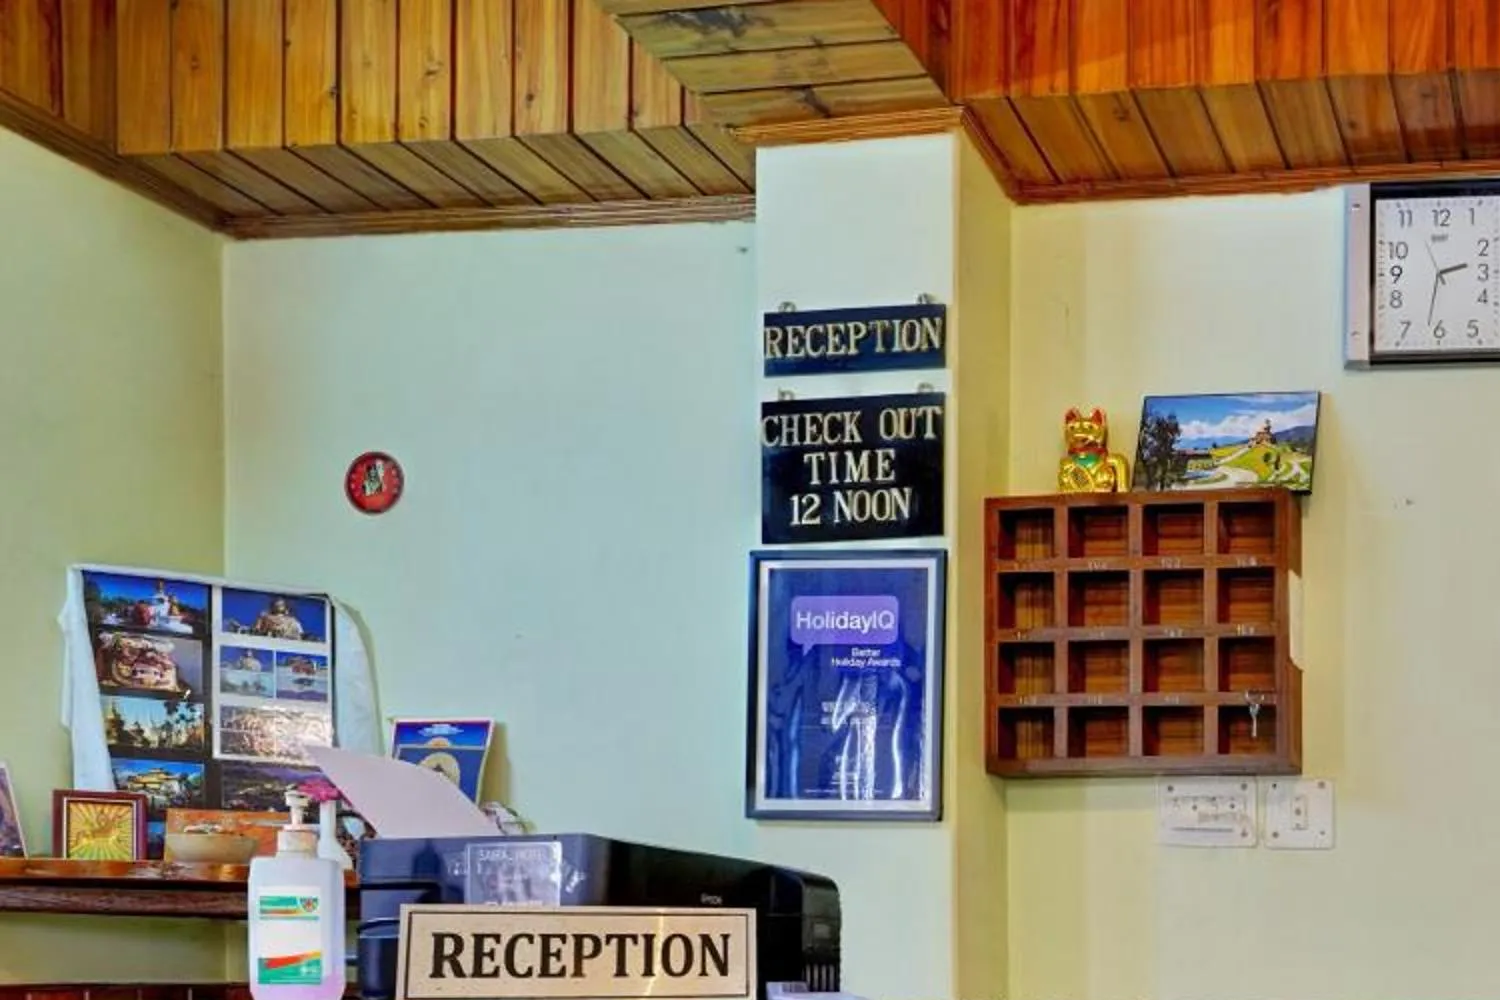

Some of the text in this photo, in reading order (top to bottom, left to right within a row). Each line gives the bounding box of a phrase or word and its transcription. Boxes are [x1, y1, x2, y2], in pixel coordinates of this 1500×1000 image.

[1398, 207, 1475, 228] 11 12 1
[1388, 241, 1409, 260] 10
[1477, 238, 1489, 257] 2
[1389, 265, 1403, 284] 9
[1477, 263, 1489, 282] 3
[1389, 290, 1403, 309] 8
[1477, 288, 1488, 304] 4
[764, 317, 943, 359] RECEPTION
[1400, 321, 1412, 339] 7
[1433, 320, 1446, 339] 6
[1466, 319, 1479, 338] 5
[762, 405, 942, 447] CHECK OUT
[803, 448, 896, 486] TIME
[789, 487, 912, 526] 12 NOON
[796, 610, 896, 635] HolidayIQ
[429, 932, 731, 979] RECEPTION
